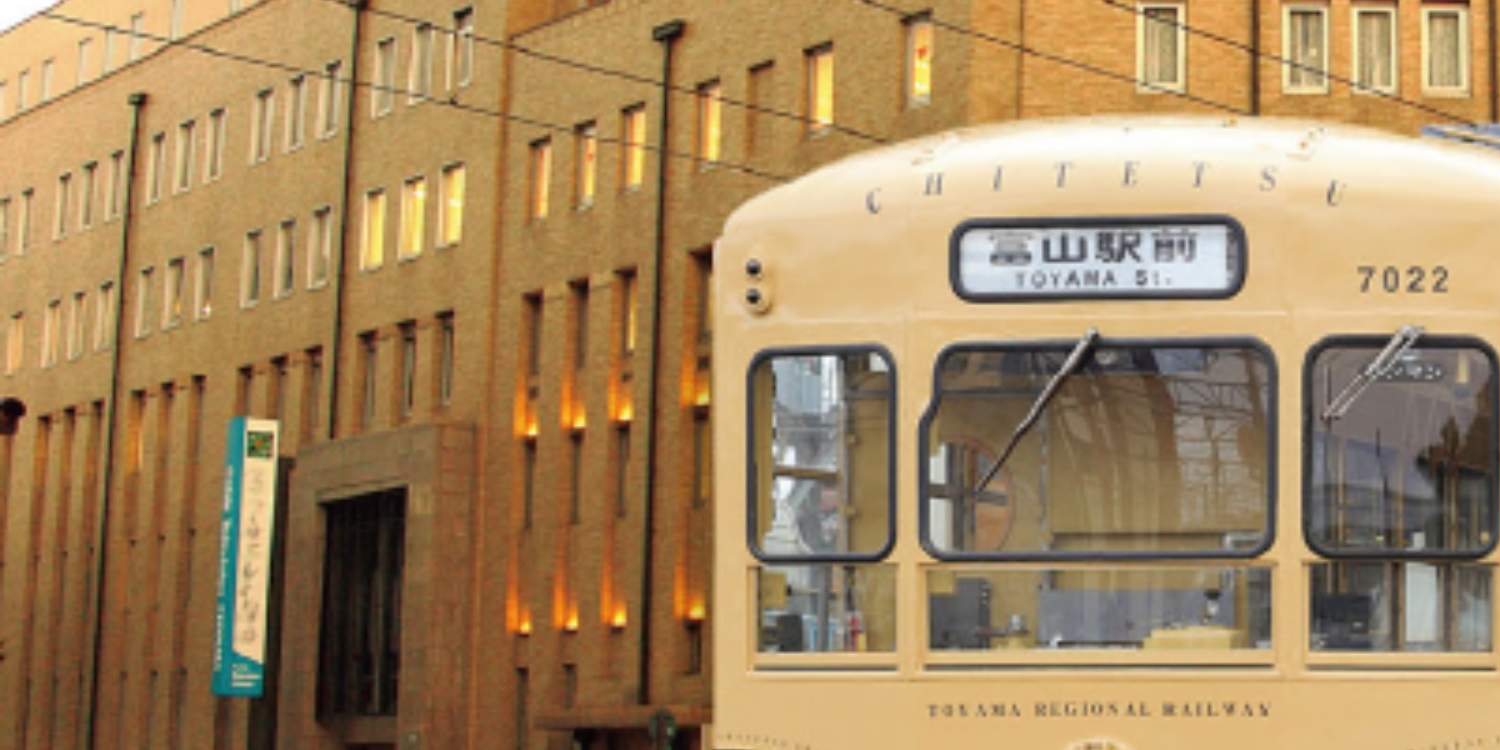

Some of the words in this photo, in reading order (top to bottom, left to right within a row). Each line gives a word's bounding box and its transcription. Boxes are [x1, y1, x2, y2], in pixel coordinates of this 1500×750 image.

[865, 160, 1346, 214] CHITETSU
[989, 227, 1197, 266] 富山駅前
[1015, 270, 1118, 288] TOYAMA
[1357, 265, 1448, 293] 7022
[928, 703, 1021, 717] TOYAMA
[1034, 701, 1151, 717] REGIONAL
[1162, 702, 1270, 717] RAILWAY
